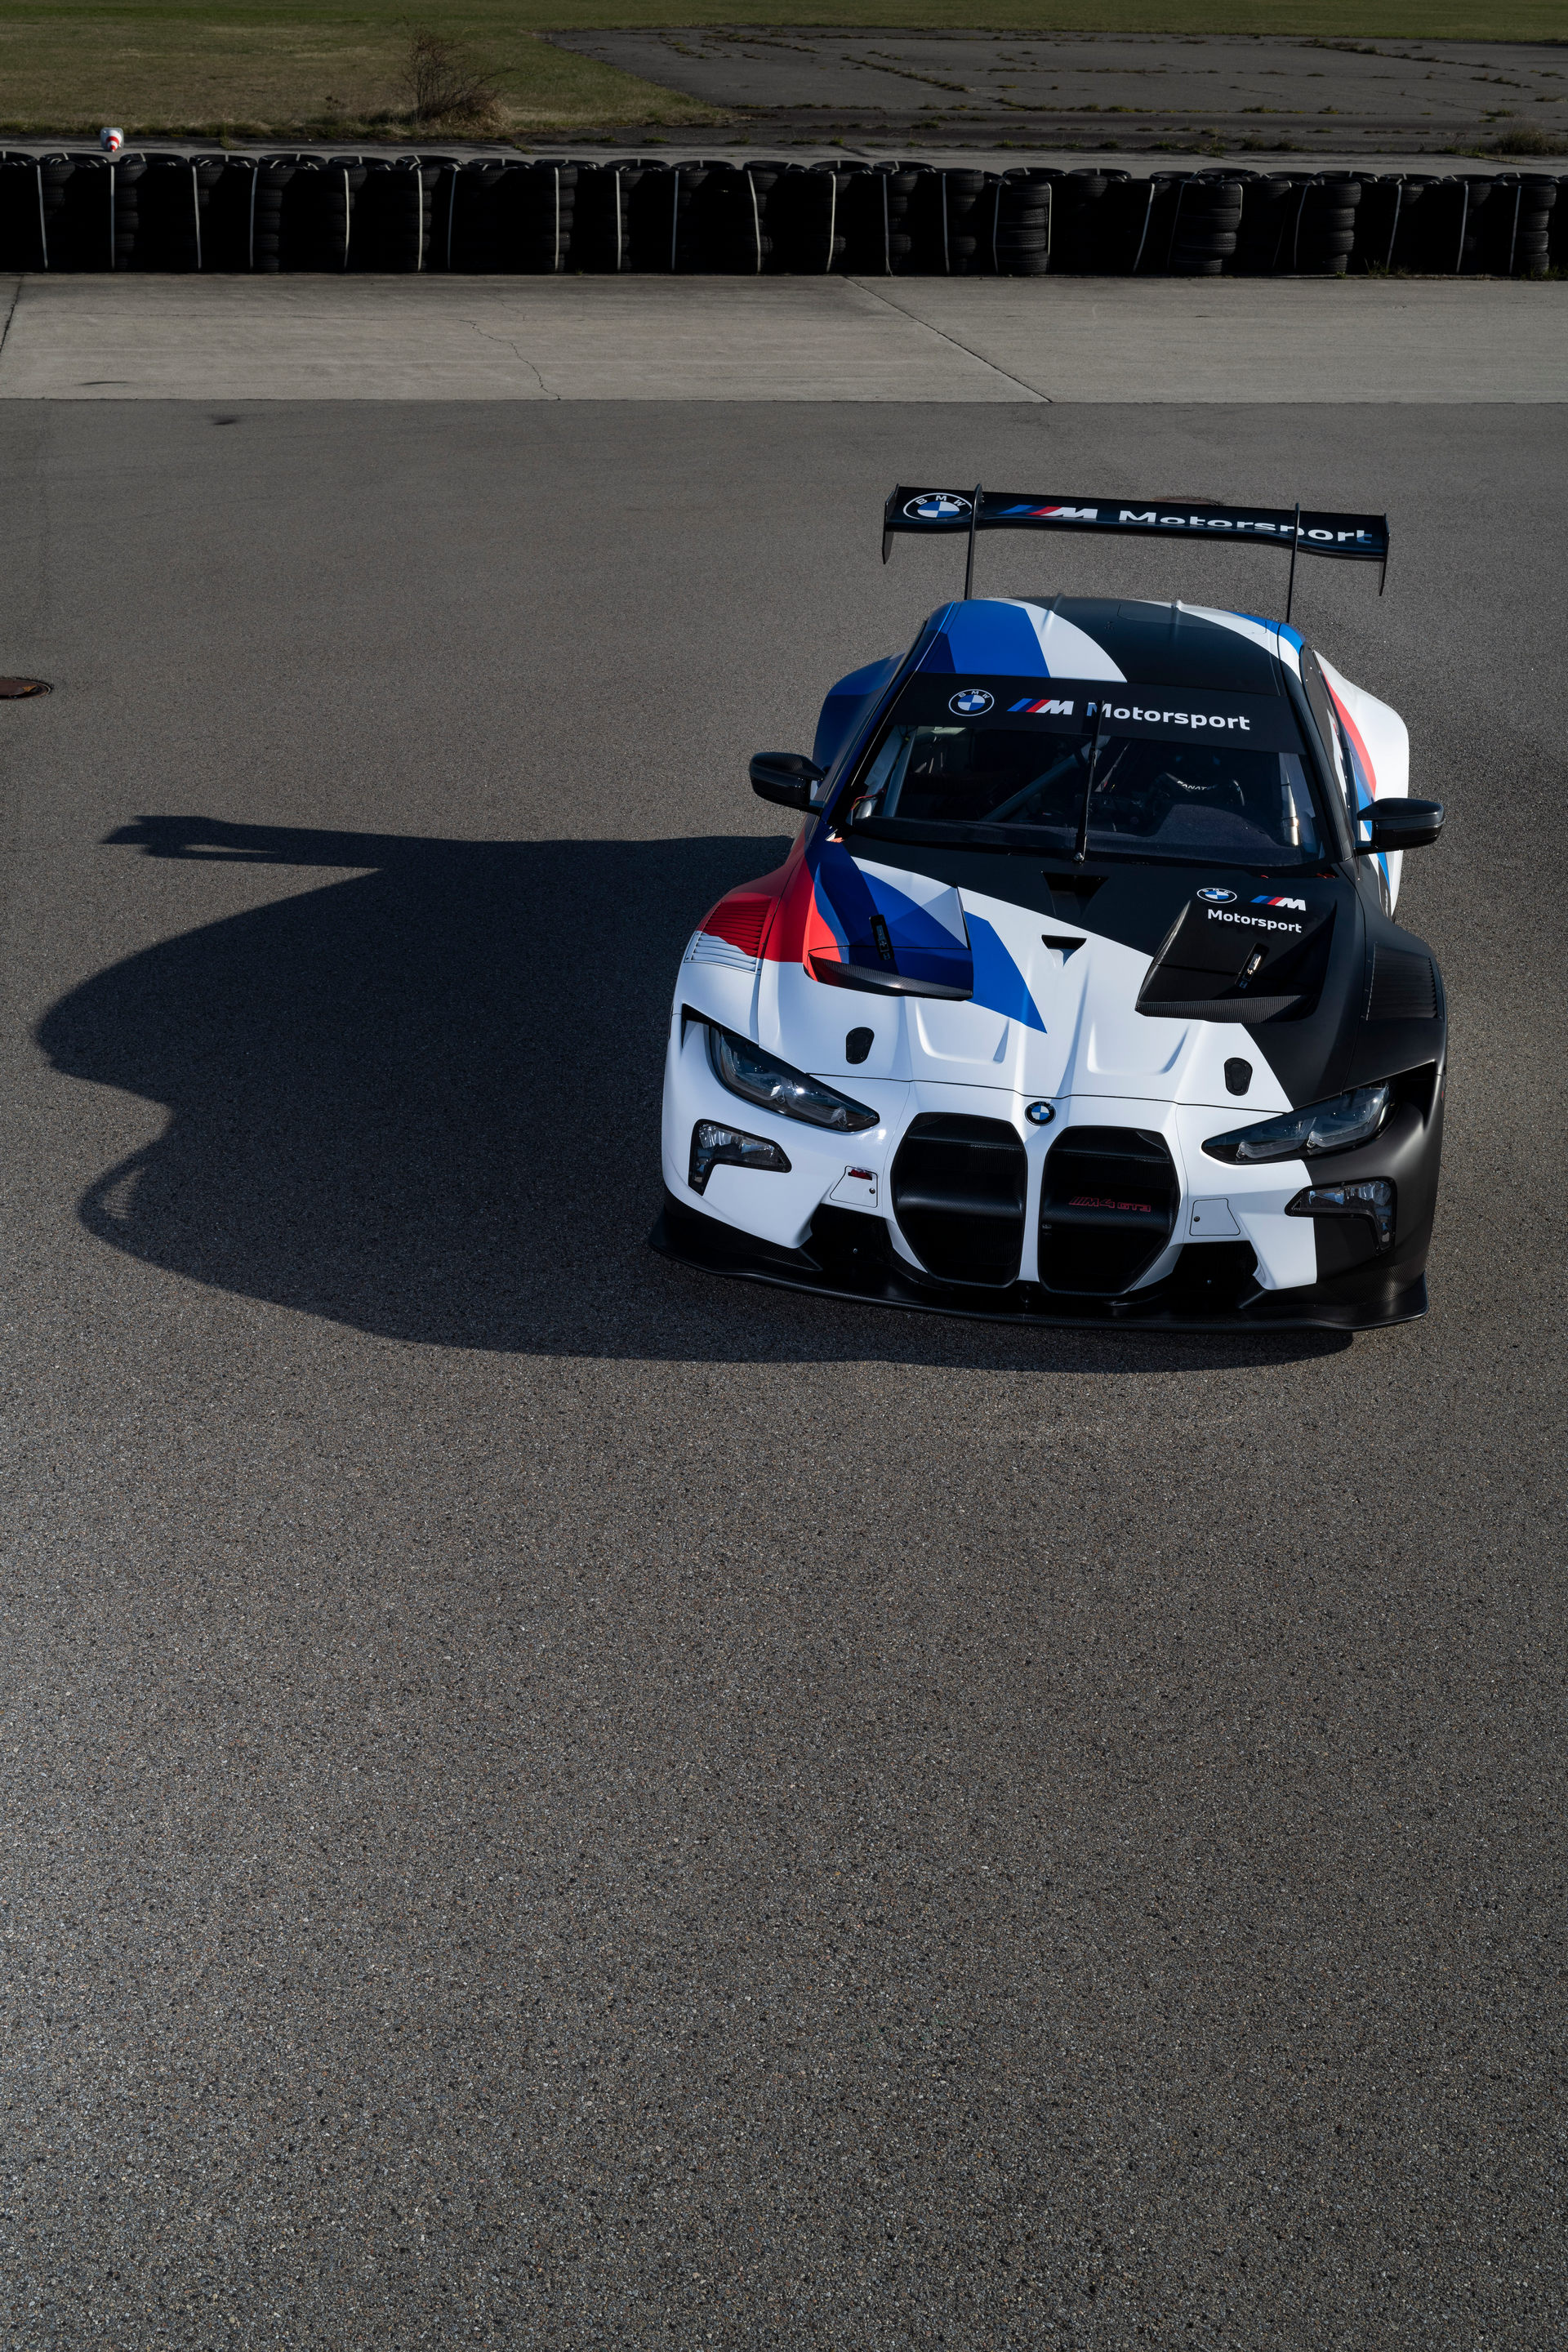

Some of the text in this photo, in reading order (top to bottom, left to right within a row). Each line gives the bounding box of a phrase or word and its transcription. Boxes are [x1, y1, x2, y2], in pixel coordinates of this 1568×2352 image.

[1119, 510, 1373, 544] Motorsport
[1086, 702, 1250, 730] Motorsport
[1208, 909, 1302, 933] Motorsport
